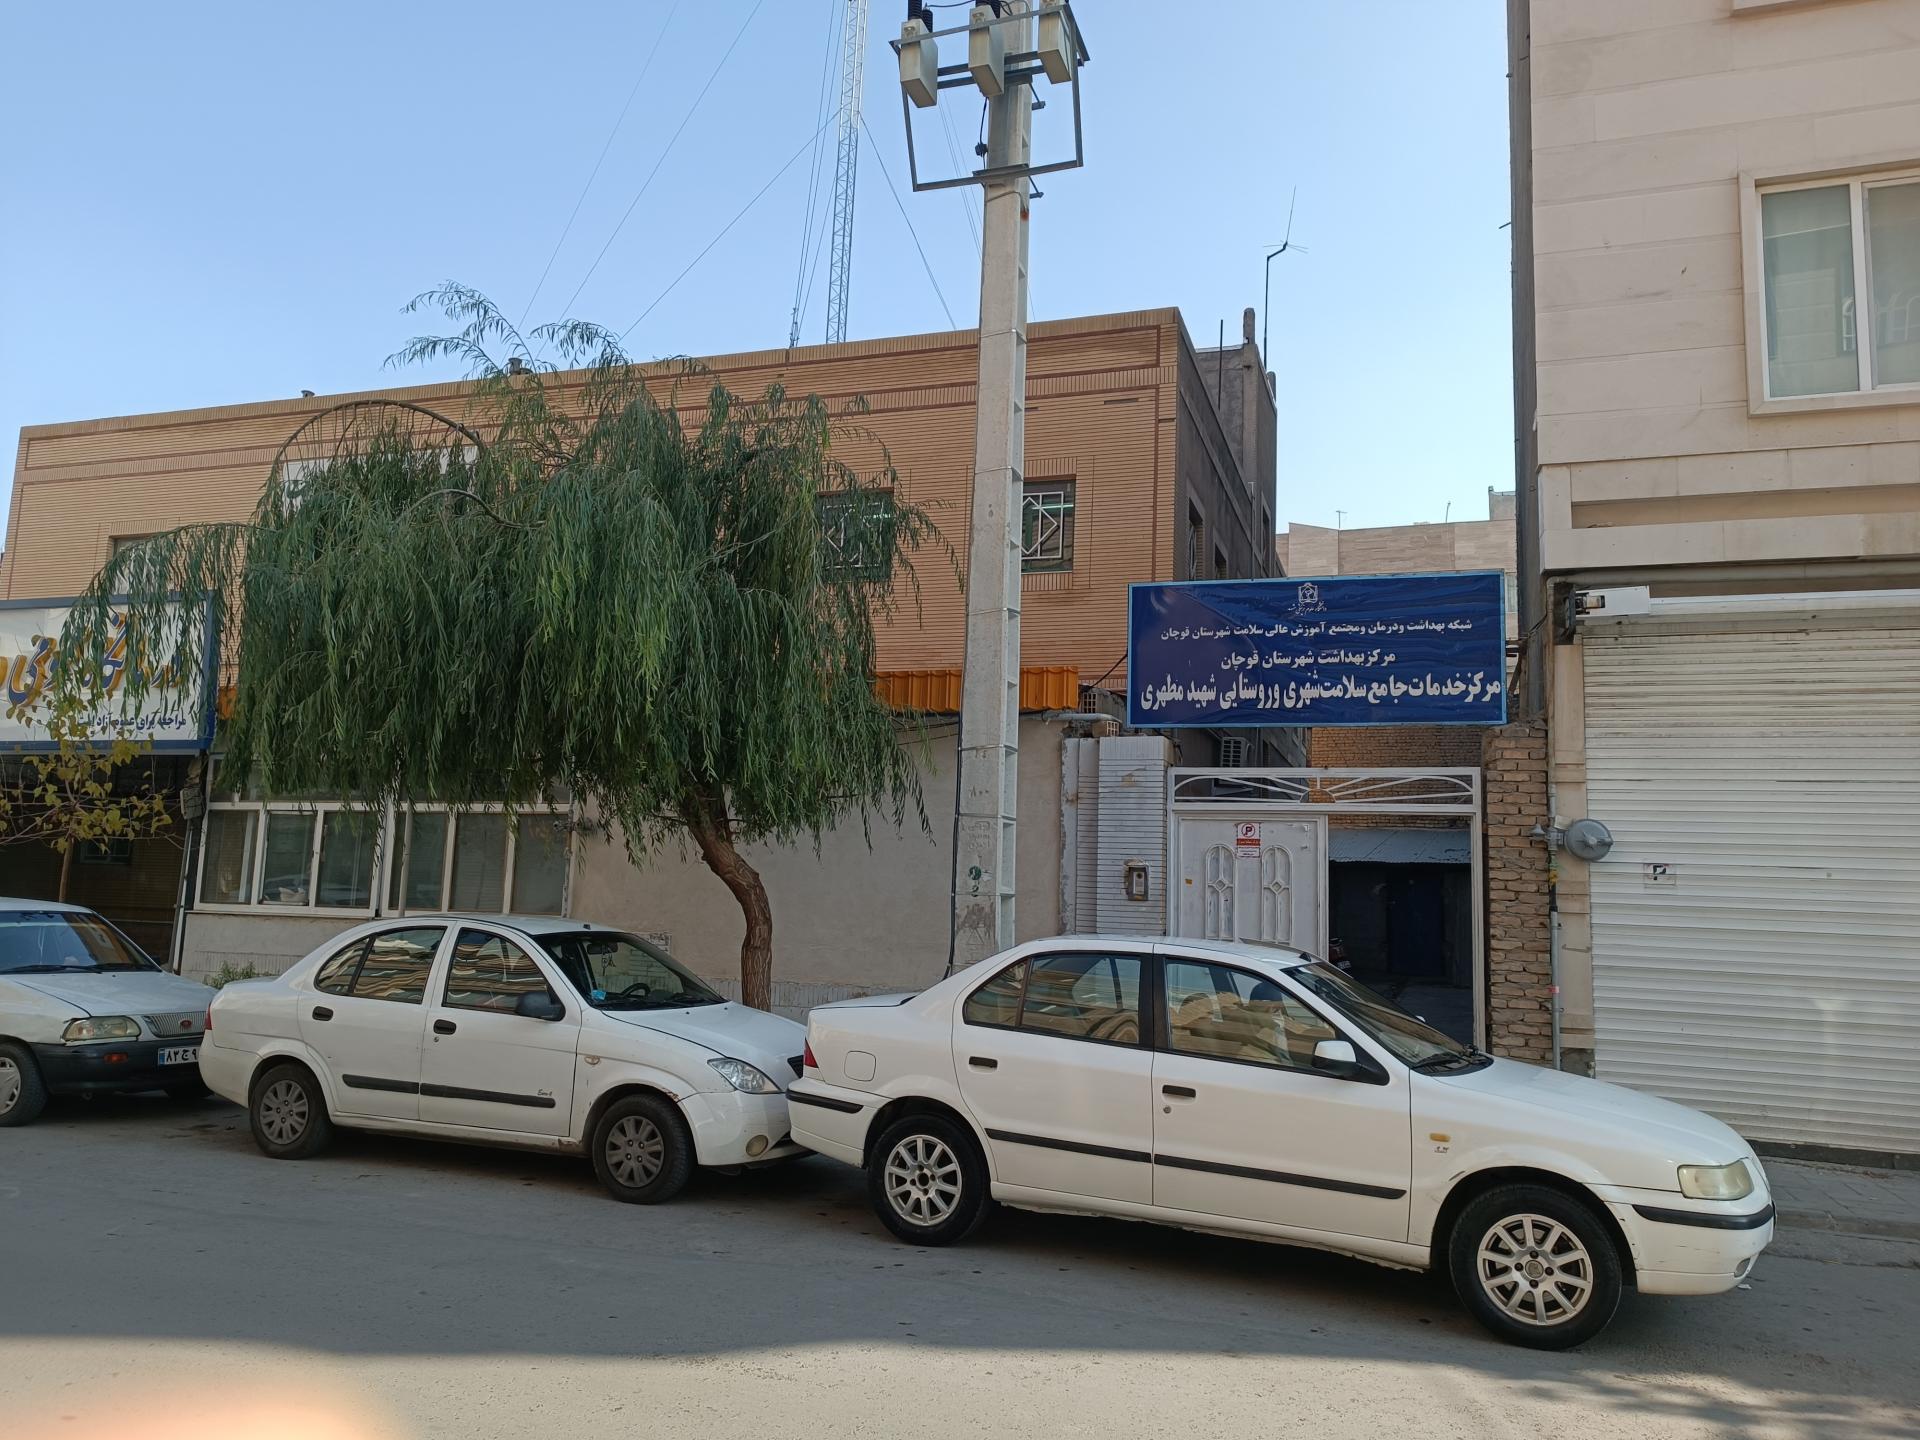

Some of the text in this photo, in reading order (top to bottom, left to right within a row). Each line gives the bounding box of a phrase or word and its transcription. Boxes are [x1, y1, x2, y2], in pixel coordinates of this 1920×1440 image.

[1160, 626, 1190, 641] قوچان
[1191, 625, 1231, 640] شهرستان
[1233, 624, 1264, 635] سلامت
[1264, 623, 1289, 637] عالی
[1290, 621, 1327, 637] آموزش
[1406, 619, 1446, 634] بهداشت
[1447, 619, 1473, 632] شبکه
[1220, 650, 1260, 670] قوچان
[1262, 649, 1315, 669] شهرستان
[1140, 674, 1184, 711] مطهری
[1186, 673, 1217, 709] شهید
[1283, 669, 1321, 709] شهری
[1319, 674, 1367, 699] سلامت
[1367, 675, 1408, 704] جامع
[1409, 673, 1466, 697] خدمات
[1464, 671, 1501, 703] مرکز
